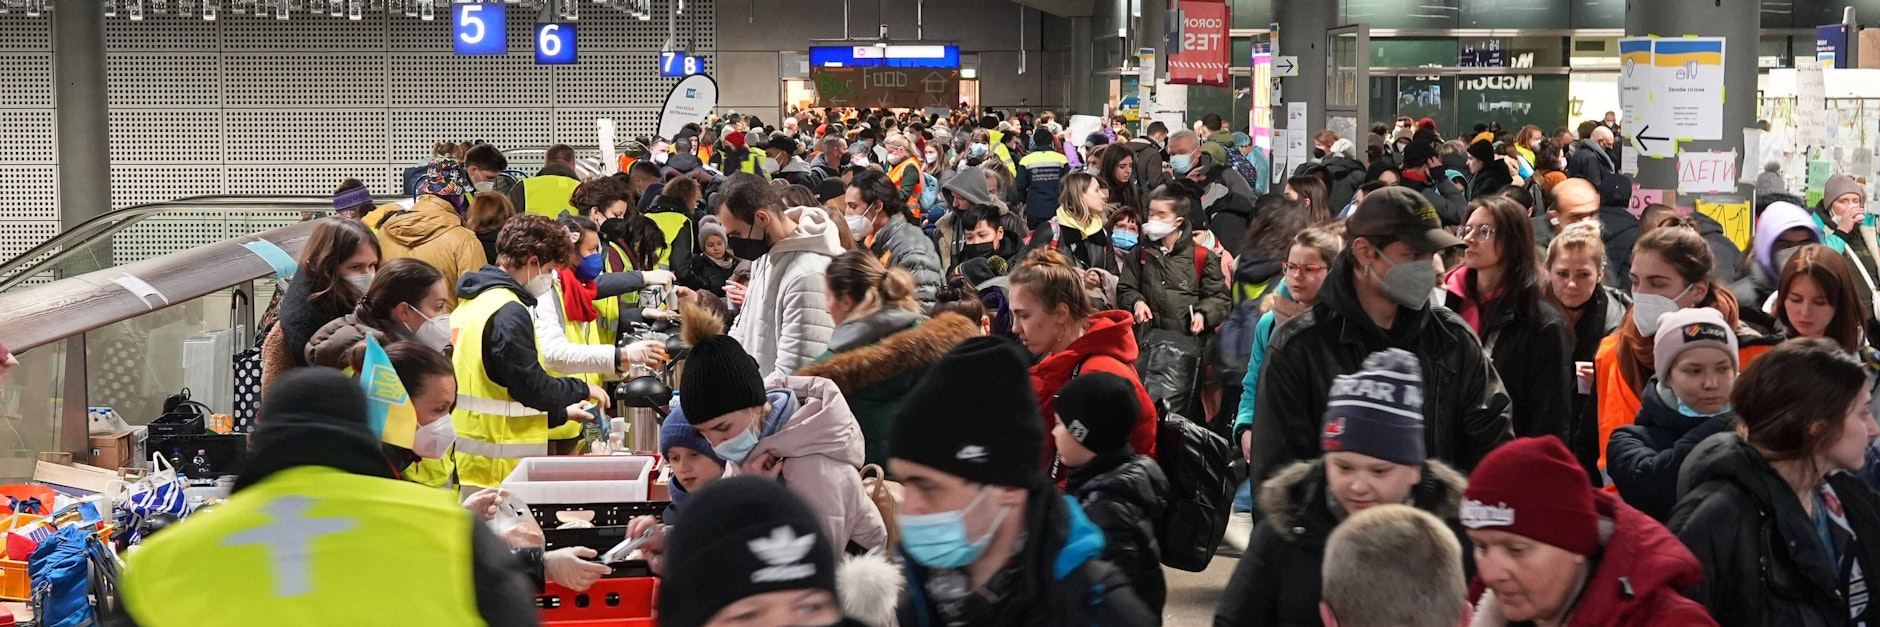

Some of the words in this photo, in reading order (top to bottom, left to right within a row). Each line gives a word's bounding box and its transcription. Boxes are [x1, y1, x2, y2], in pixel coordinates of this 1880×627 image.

[459, 4, 486, 44] 5
[539, 24, 561, 56] 6
[662, 52, 676, 73] 7
[684, 56, 697, 75] 8
[1681, 159, 1735, 184] ДЕТИ
